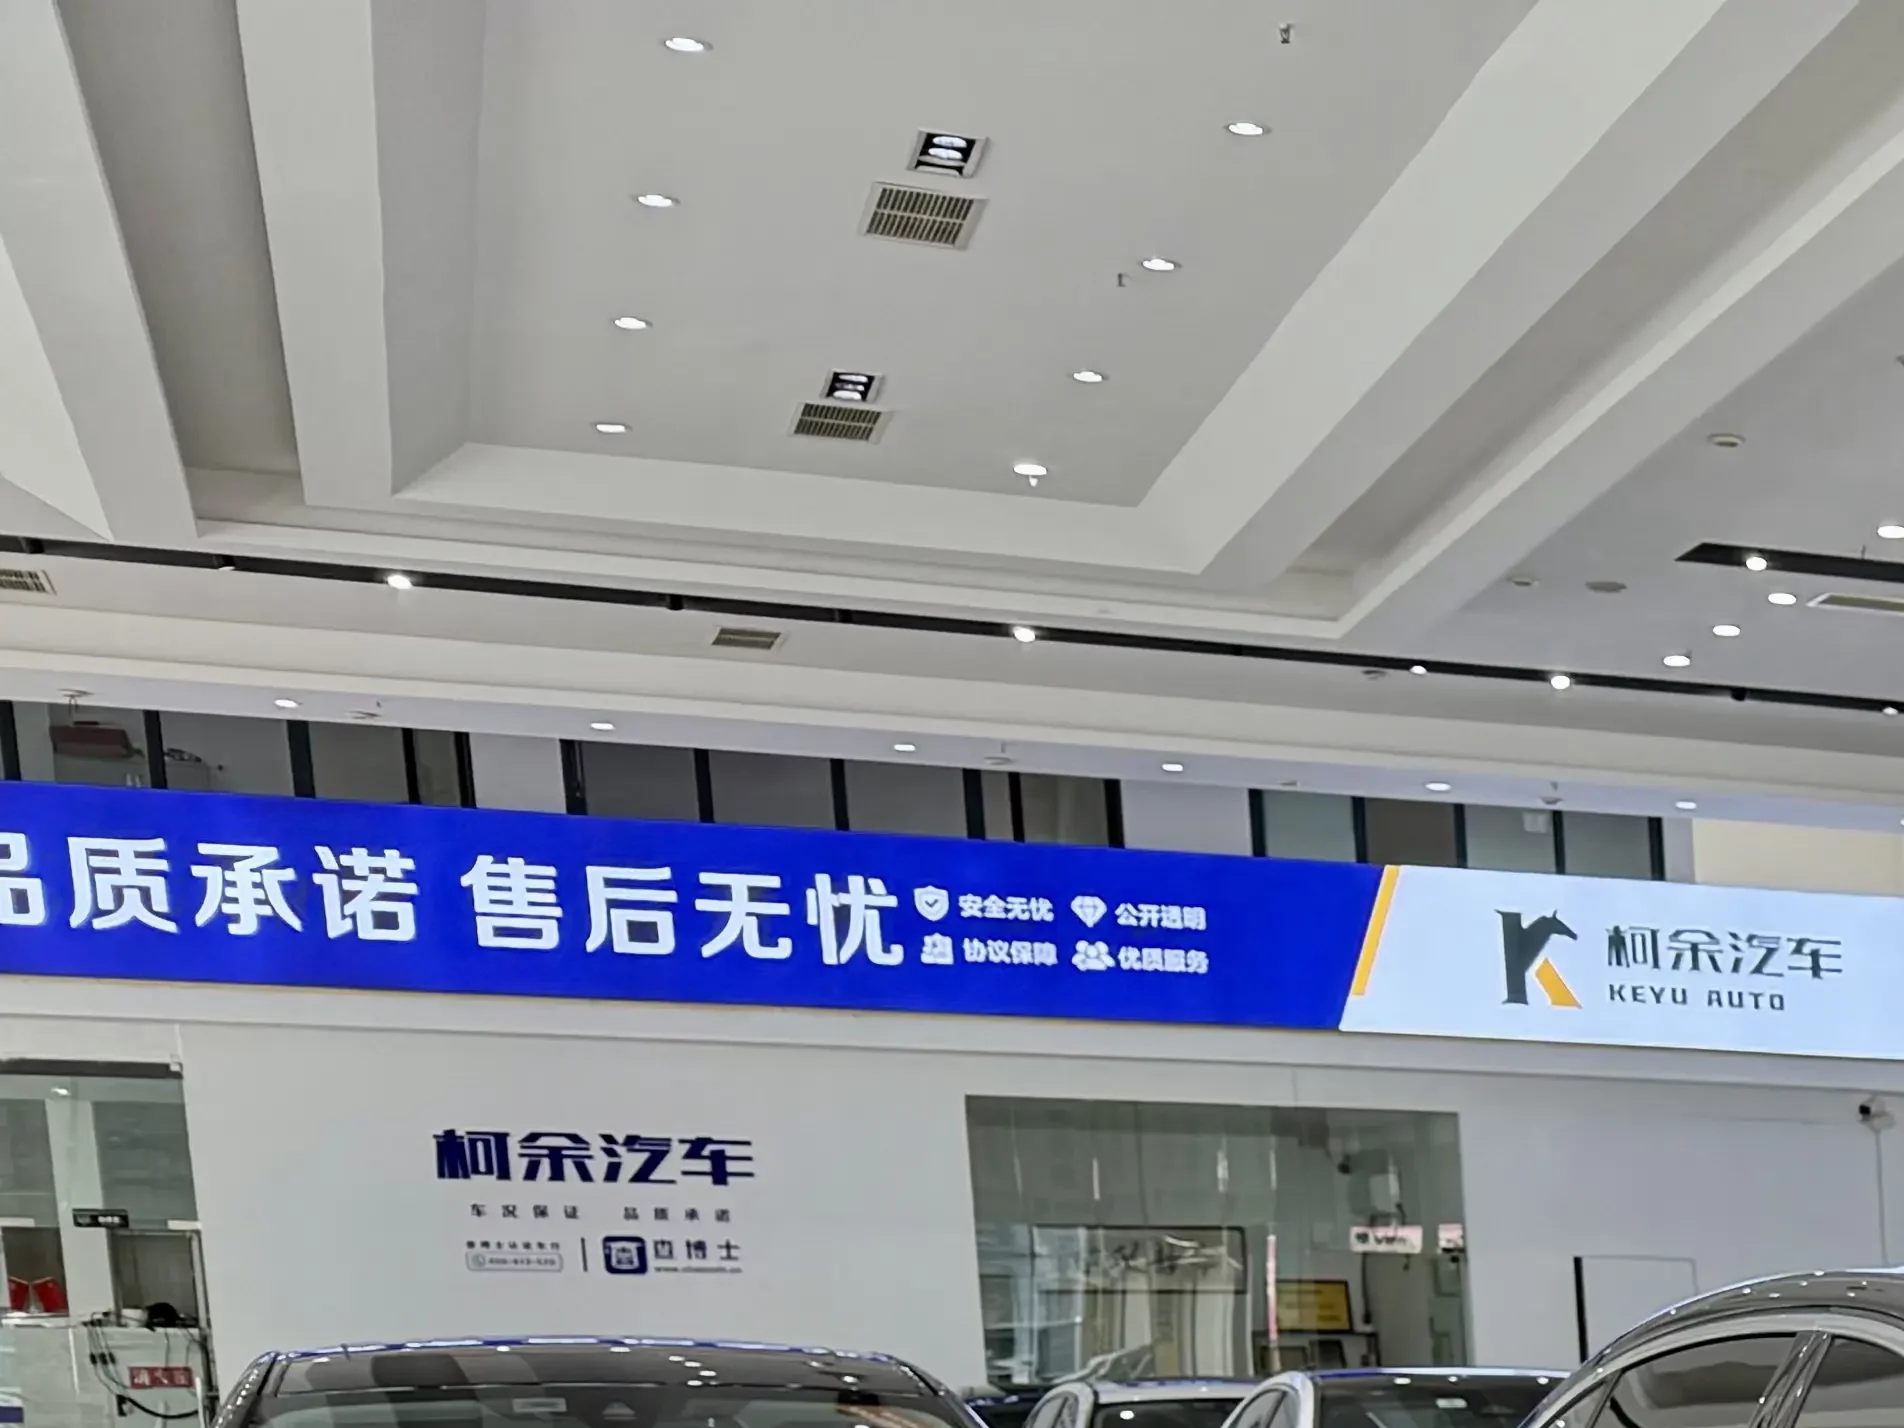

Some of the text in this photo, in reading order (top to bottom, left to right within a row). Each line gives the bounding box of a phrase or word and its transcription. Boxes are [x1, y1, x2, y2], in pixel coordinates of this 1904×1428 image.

[461, 853, 905, 967] 售后无忧
[958, 893, 1207, 931] 安全无忧 公开透明
[962, 937, 1210, 975] 协议保障 优质服务
[1604, 923, 1844, 983] 柯余汽车
[1607, 983, 1787, 1012] KEYU AUTO
[433, 1129, 755, 1186] 柯余汽车
